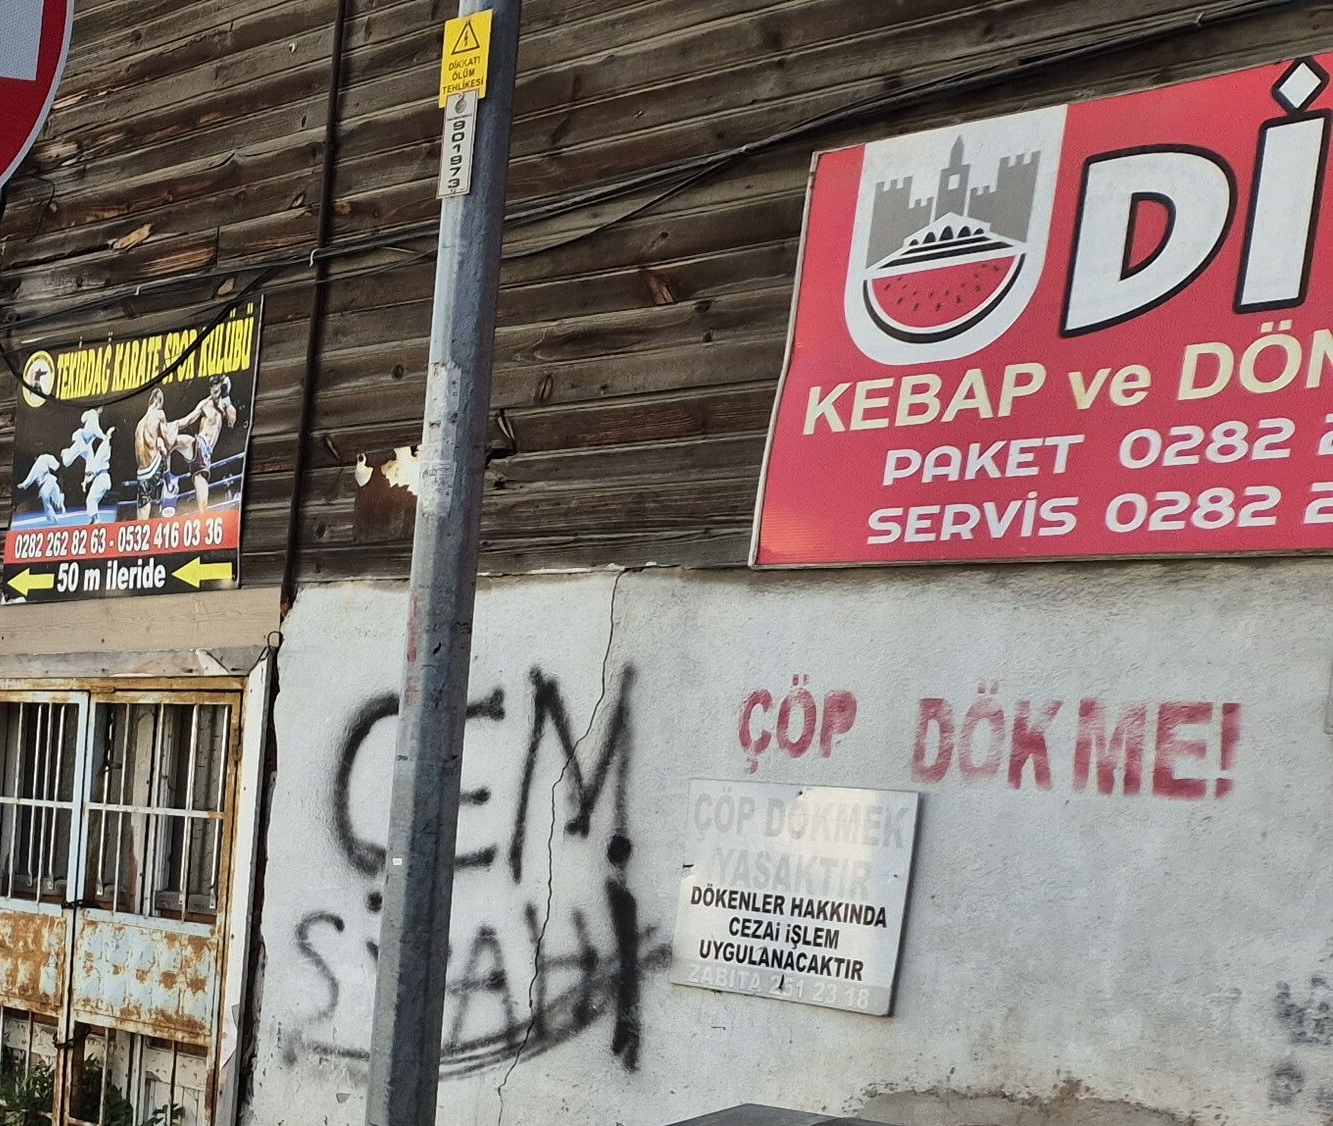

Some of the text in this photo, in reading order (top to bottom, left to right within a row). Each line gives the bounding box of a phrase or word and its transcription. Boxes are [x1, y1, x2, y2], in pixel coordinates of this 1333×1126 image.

[448, 120, 466, 188] 901973
[111, 335, 163, 391] KARATE
[162, 330, 198, 384] SPOR
[198, 303, 254, 377] KULÜBÜ
[802, 362, 1047, 435] KEBAP
[1068, 364, 1152, 410] ve
[882, 434, 1085, 486] PAKET
[1118, 417, 1295, 469] 0282
[14, 533, 43, 559] 0282
[45, 531, 70, 557] 262
[71, 529, 88, 555] 82
[90, 527, 106, 554] 63
[117, 524, 151, 552] 0532
[153, 520, 180, 548] 416
[183, 518, 201, 546] 03
[204, 516, 223, 545] 36
[867, 491, 1079, 545] SERVİS
[1105, 485, 1282, 533] 0282
[56, 557, 167, 593] 50 m ileride
[738, 674, 1243, 800] ÇÖP DÖKME!
[693, 787, 909, 849] ÇÖP DÖKMEK
[713, 847, 871, 901] YASAKTIR
[691, 883, 887, 928] DÖKENLER HAKKINDA
[699, 938, 864, 982] UYGULANACAKTIR
